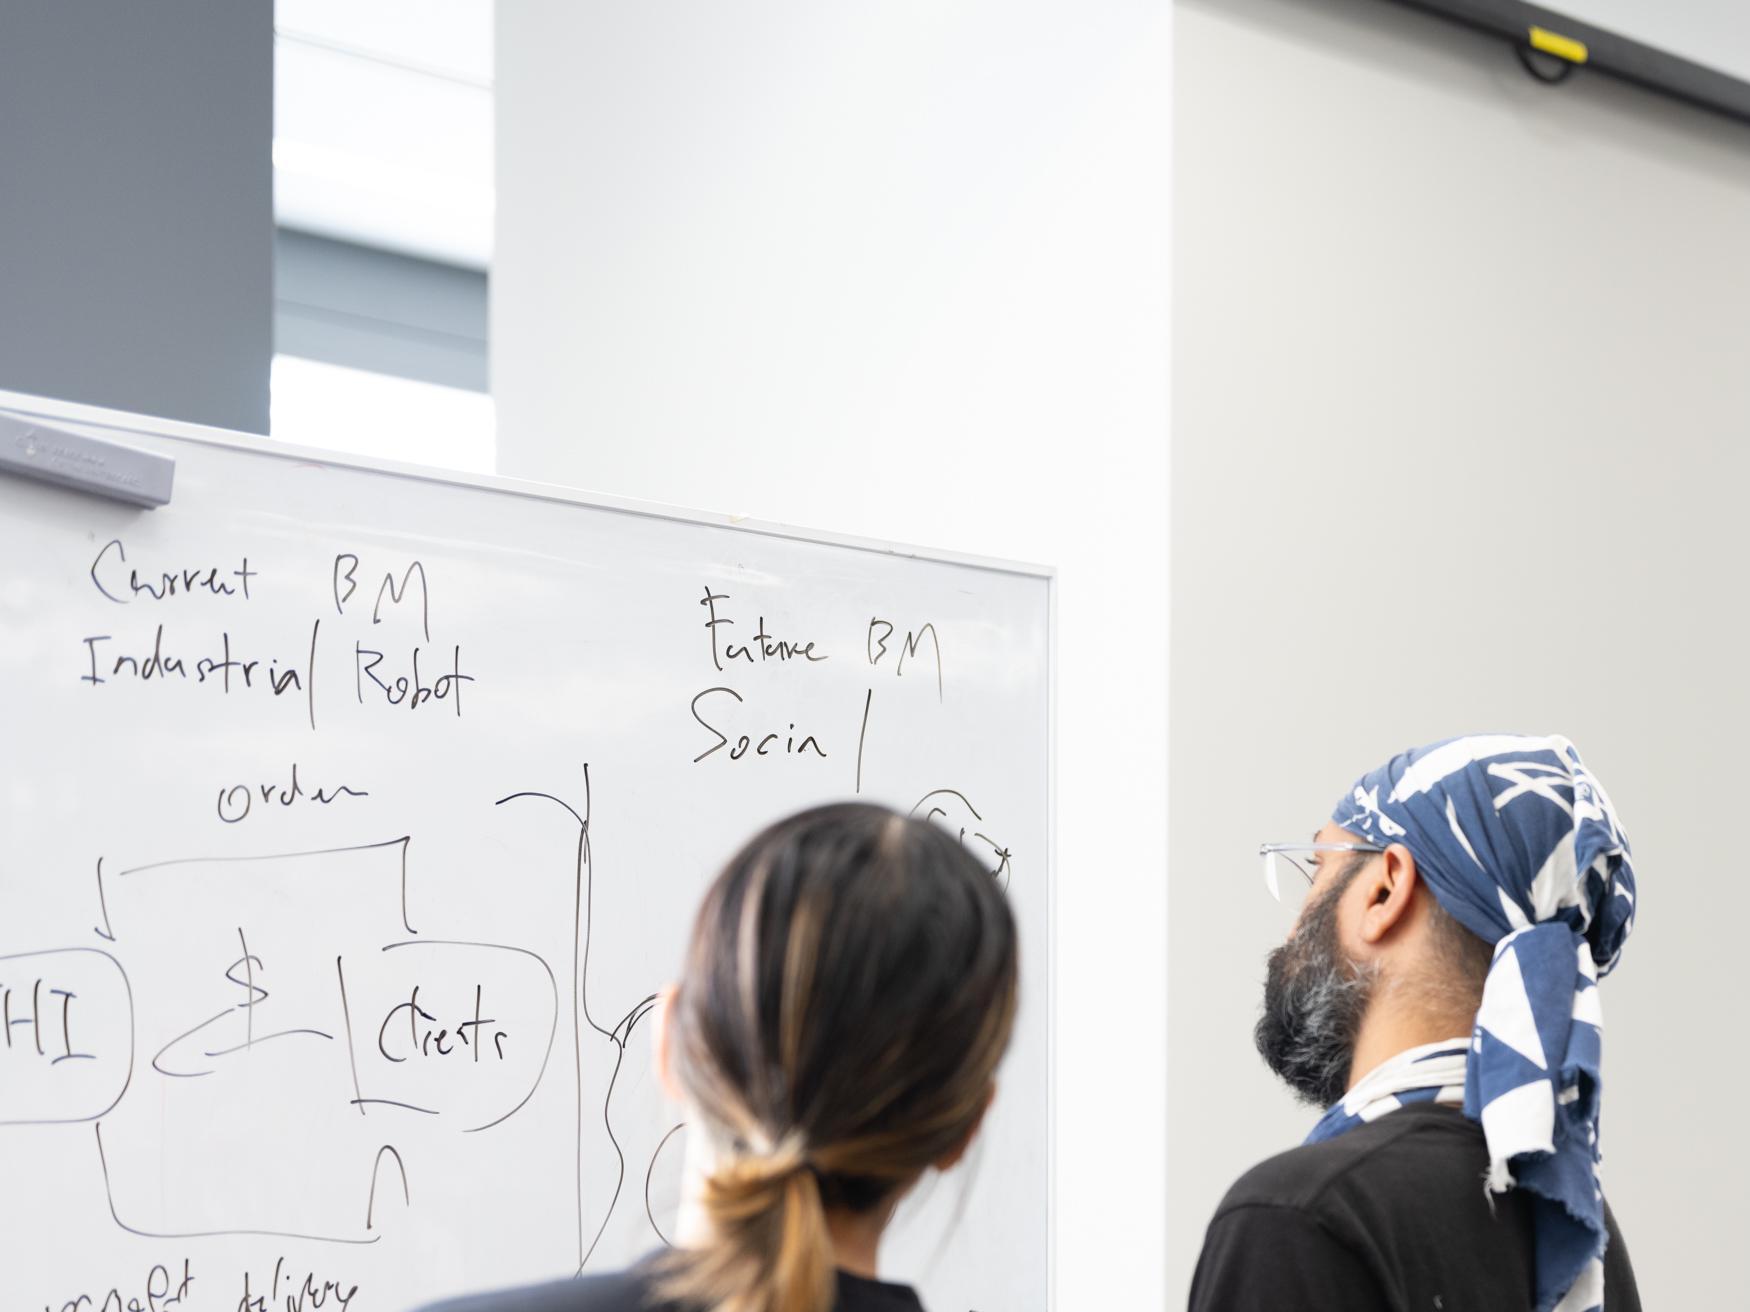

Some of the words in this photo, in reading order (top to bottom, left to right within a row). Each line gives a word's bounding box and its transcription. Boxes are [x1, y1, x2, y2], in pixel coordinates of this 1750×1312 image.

[90, 539, 258, 604] Current
[333, 554, 430, 643] BM
[700, 585, 829, 672] Future
[866, 617, 943, 705] BM
[81, 618, 320, 730] Industrial
[356, 640, 475, 717] Robot
[691, 687, 872, 794] Social
